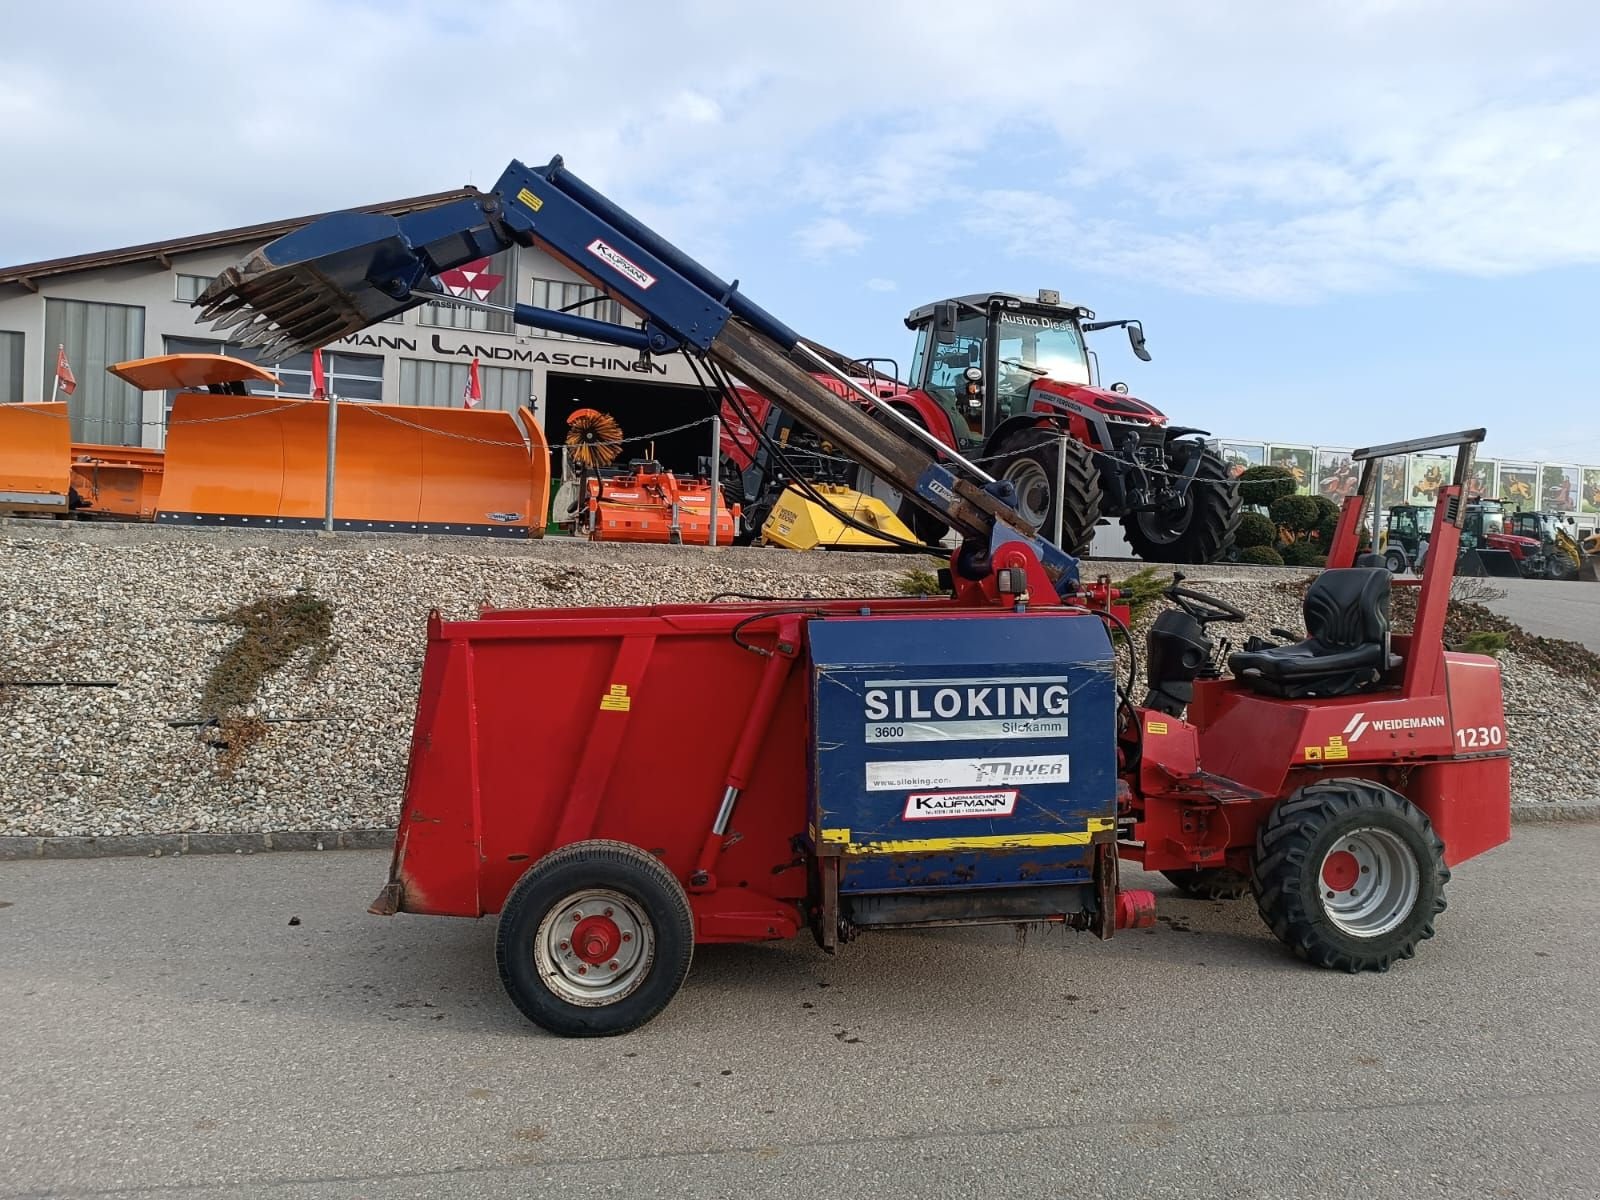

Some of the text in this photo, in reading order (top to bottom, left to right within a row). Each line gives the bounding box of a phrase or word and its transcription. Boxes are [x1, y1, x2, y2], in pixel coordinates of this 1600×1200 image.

[1001, 311, 1075, 333] Austro Diesel
[431, 334, 667, 375] LANDMASCHINEN
[864, 684, 1069, 720] SILOKING
[874, 726, 904, 738] 3600
[1372, 715, 1446, 731] WEIDEMANN
[1456, 726, 1502, 748] 1230
[916, 797, 1006, 809] KAUFMANN
